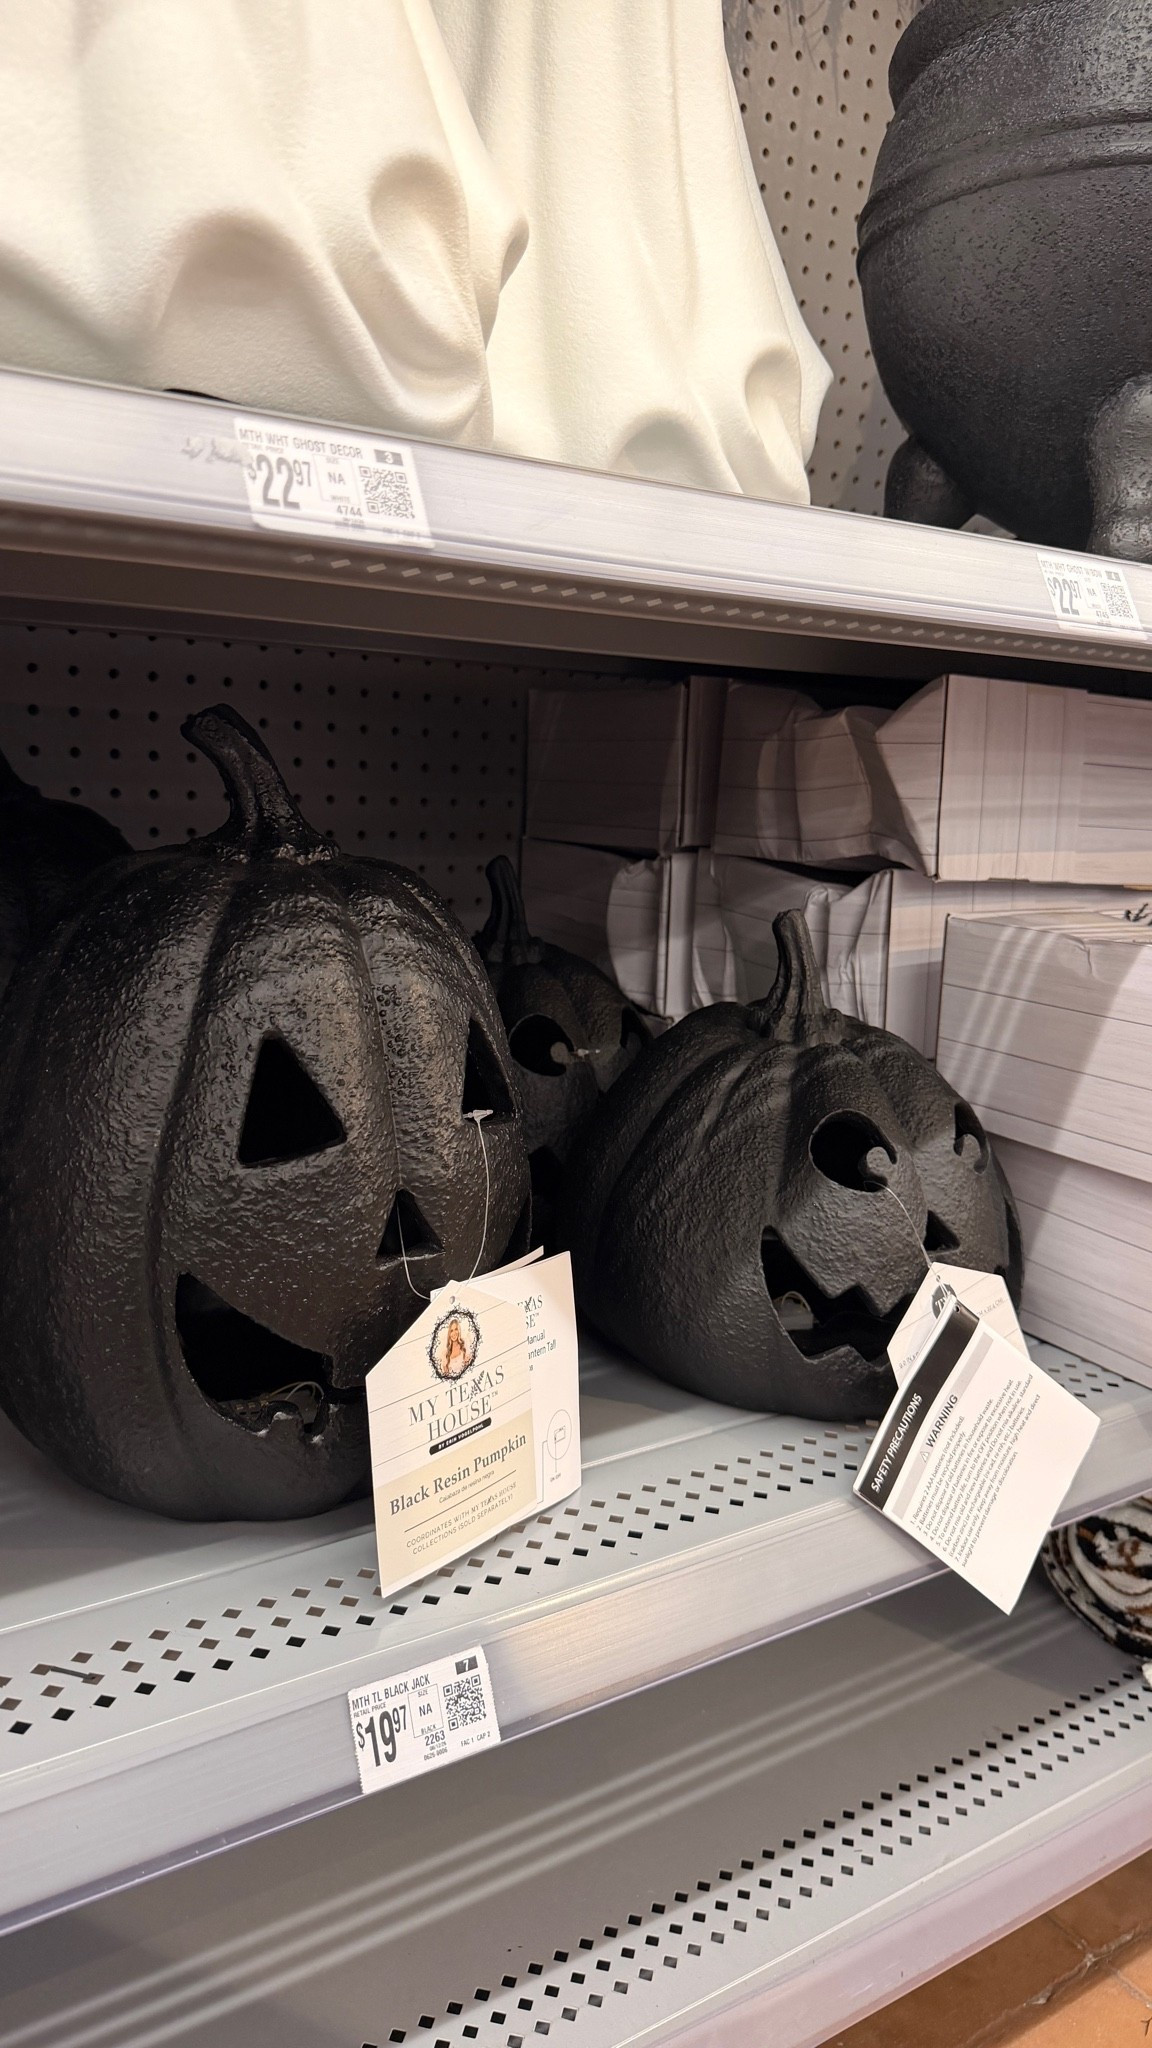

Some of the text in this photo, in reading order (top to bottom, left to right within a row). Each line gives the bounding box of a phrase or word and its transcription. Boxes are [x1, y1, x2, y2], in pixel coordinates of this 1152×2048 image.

[265, 432, 290, 448] WHT
[292, 436, 326, 454] GHOST
[329, 442, 364, 460] DECOR
[327, 470, 346, 486] NA
[336, 504, 363, 518] 4744
[408, 1365, 504, 1426] MY TEXAS
[926, 1394, 958, 1448] WARNING
[871, 1454, 892, 1493] SAFETY
[886, 1392, 922, 1459] PRECAUTIONS
[977, 1498, 986, 1513] Keep
[984, 1483, 994, 1498] away
[990, 1470, 999, 1483] from
[1009, 1432, 1019, 1445] high
[1016, 1420, 1026, 1433] heat
[1024, 1408, 1032, 1421] and
[1030, 1394, 1040, 1410] direct
[951, 1492, 963, 1513] battery
[978, 1441, 986, 1454] OFF
[985, 1421, 999, 1444] position
[997, 1406, 1008, 1421] when
[389, 1434, 526, 1516] Black Resin Pumpkin
[482, 1470, 495, 1483] negra
[926, 1477, 934, 1491] AAA
[936, 1477, 943, 1486] be
[925, 1521, 933, 1530] Do
[936, 1488, 947, 1510] dispose
[945, 1480, 950, 1489] of
[932, 1526, 939, 1536] Do
[942, 1494, 953, 1516] dispose
[951, 1486, 956, 1494] of
[967, 1448, 975, 1458] fire
[944, 1537, 952, 1546] Do
[990, 1438, 998, 1447] Do
[406, 1520, 452, 1548] COORDINATES
[454, 1510, 470, 1522] WITH
[471, 1504, 480, 1513] MY
[962, 1543, 974, 1568] sunlight
[975, 1514, 987, 1538] prevent
[985, 1492, 997, 1516] damage
[412, 1528, 457, 1555] COLLECTIONS
[463, 1659, 469, 1672] 7
[351, 1674, 430, 1711] MTH TL BLACK JACK
[353, 1702, 386, 1718] RETAIL PRICE
[418, 1703, 433, 1717] NA
[421, 1724, 437, 1735] BLACK
[424, 1730, 446, 1746] 2263
[461, 1737, 470, 1747] FAC
[476, 1733, 486, 1742] CAP
